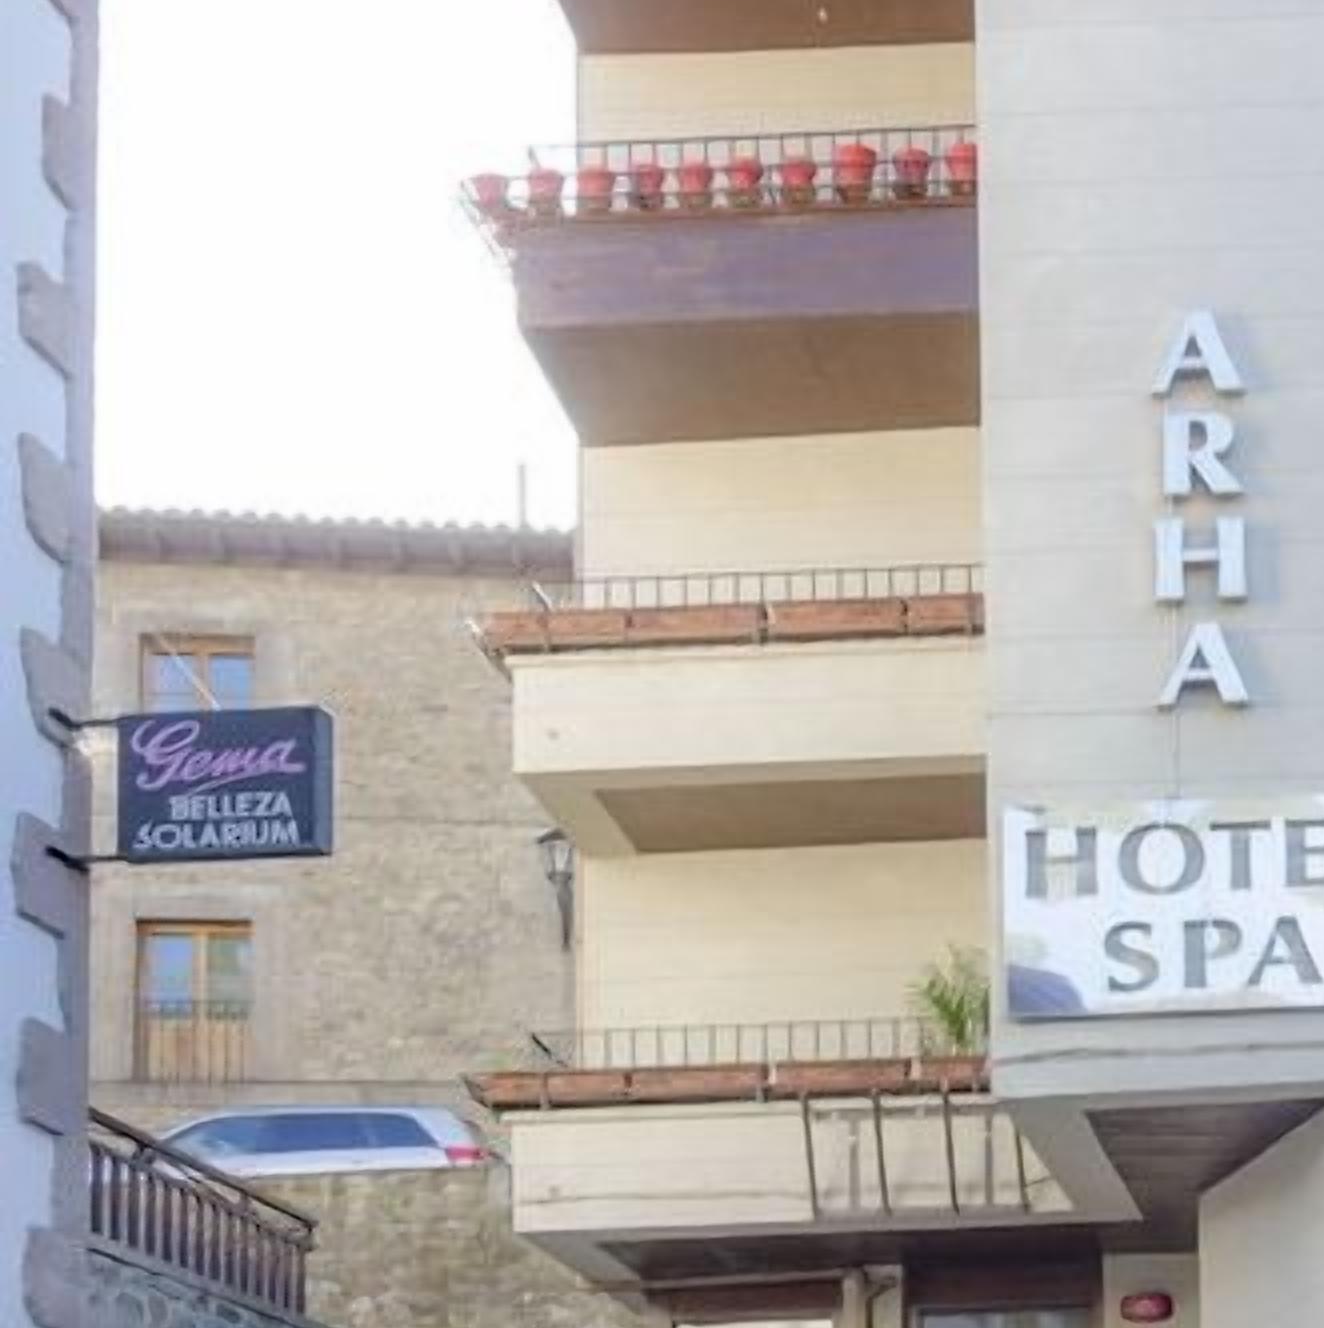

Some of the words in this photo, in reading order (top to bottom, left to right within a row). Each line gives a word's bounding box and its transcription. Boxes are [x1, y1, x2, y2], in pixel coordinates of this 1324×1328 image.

[1151, 309, 1249, 709] ARHA
[130, 719, 306, 792] Gema
[132, 820, 301, 849] SOLARIUM
[168, 791, 293, 820] BELLEZA
[1105, 916, 1324, 992] SPA
